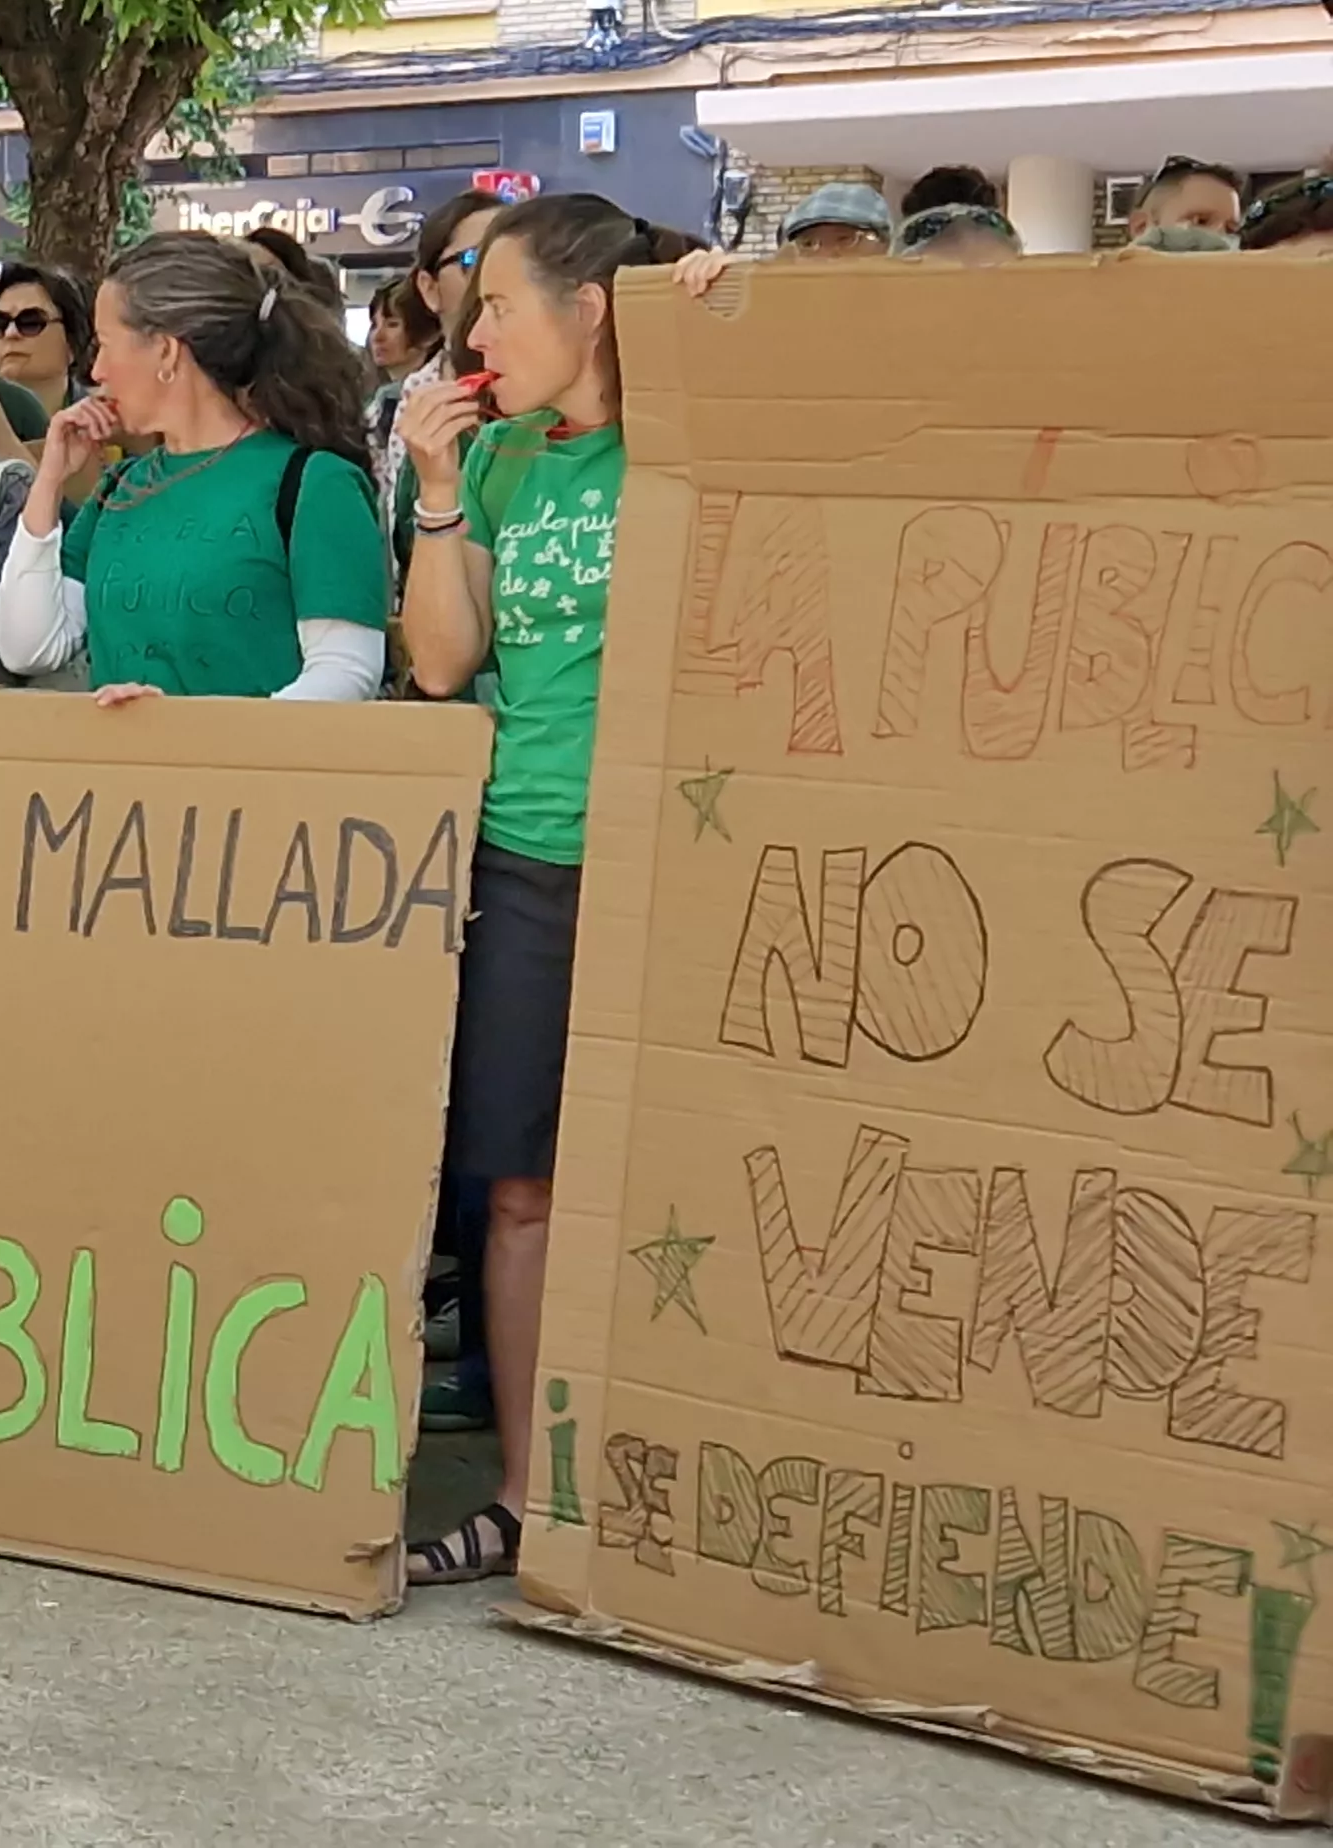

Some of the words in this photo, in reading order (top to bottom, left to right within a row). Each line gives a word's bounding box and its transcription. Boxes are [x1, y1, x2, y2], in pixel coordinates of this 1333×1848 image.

[673, 490, 844, 757] LA
[16, 789, 463, 954] MALLADA
[718, 841, 988, 1067] NO
[1042, 857, 1299, 1128] SE
[743, 1123, 1317, 1460] VENDE
